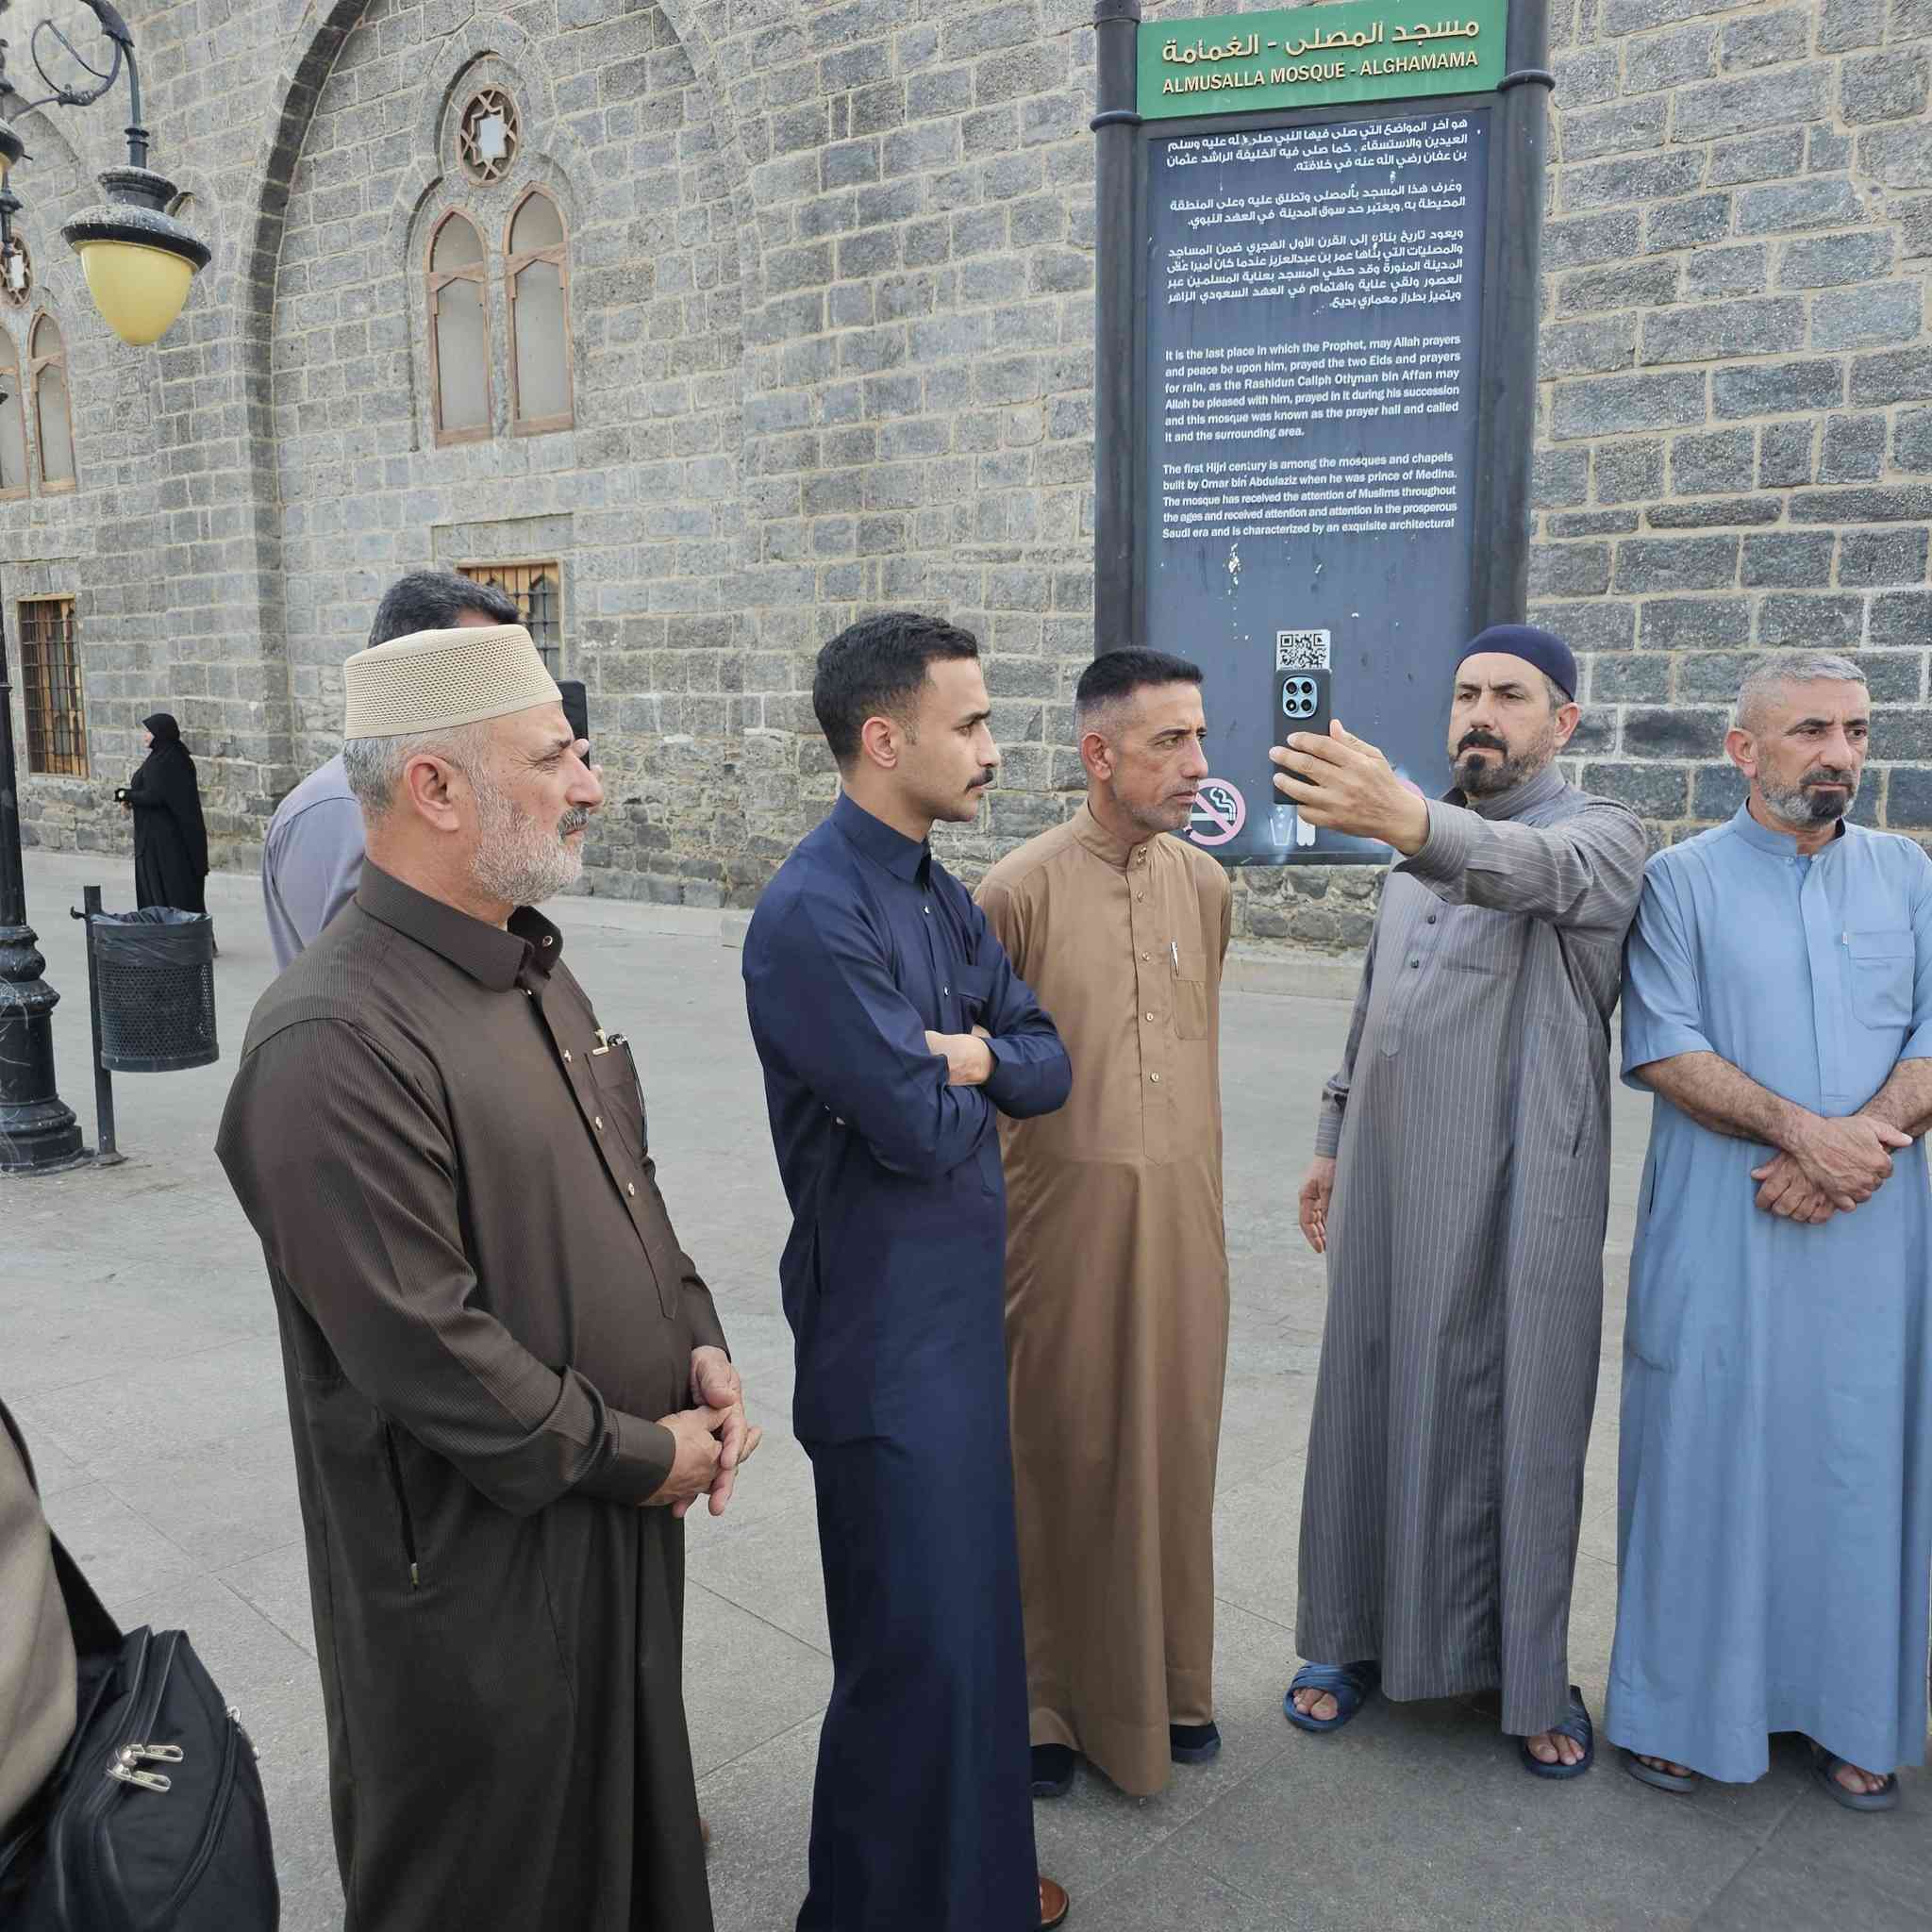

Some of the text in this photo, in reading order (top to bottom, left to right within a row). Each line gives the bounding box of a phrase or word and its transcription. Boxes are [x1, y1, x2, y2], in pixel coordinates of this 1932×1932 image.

[1285, 21, 1383, 56] المصلى
[1391, 19, 1480, 47] مسجد
[1162, 34, 1259, 64] الغمامة
[1162, 69, 1265, 94] ALMUSALLA
[1271, 61, 1346, 85] MOSQUE
[1359, 51, 1478, 76] ALGHAMAMA
[1354, 156, 1374, 166] عنه
[1376, 153, 1393, 165] الله
[1395, 152, 1422, 169] رضي
[1423, 149, 1451, 164] عفان
[1453, 149, 1467, 161] بن
[1334, 158, 1352, 173] في
[1362, 185, 1404, 200] المسجد
[1407, 183, 1427, 195] هذا
[1170, 198, 1213, 211] المنطقة
[1216, 196, 1244, 209] وعلى
[1247, 194, 1272, 208] عليه
[1274, 192, 1310, 205] وتطلق
[1357, 263, 1380, 275] وقد
[1383, 260, 1420, 275] المنورة
[1423, 257, 1462, 273] المدينة
[1187, 273, 1240, 288] المسلمين
[1241, 269, 1274, 284] بعناية
[1277, 267, 1319, 281] المسجد
[1424, 274, 1462, 287] العصور
[1167, 278, 1184, 289] عبر
[1252, 285, 1284, 295] العهد
[1287, 283, 1306, 298] في
[1308, 279, 1354, 294] واهتمام
[1357, 277, 1386, 291] عناية
[1390, 275, 1419, 291] ولقي
[1199, 287, 1248, 305] السعودي
[1174, 348, 1184, 359] is
[1186, 347, 1203, 358] the
[1205, 346, 1224, 358] last
[1226, 344, 1255, 359] place
[1257, 343, 1267, 356] in
[1269, 342, 1300, 355] which
[1302, 341, 1320, 353] the
[1322, 339, 1366, 355] Prophet,
[1369, 340, 1392, 352] may
[1392, 336, 1420, 348] Allah
[1422, 337, 1461, 349] prayers
[1165, 354, 1461, 378] and peace be upon him, prayed the two Eids and prayers
[1165, 381, 1179, 393] for
[1182, 380, 1206, 393] rain,
[1208, 382, 1221, 391] as
[1224, 378, 1241, 391] the
[1244, 376, 1294, 390] Rashidun
[1297, 375, 1331, 390] Caliph
[1401, 370, 1432, 382] Affan
[1435, 371, 1459, 383] may
[1164, 397, 1190, 409] Allah
[1191, 397, 1205, 408] be
[1207, 395, 1245, 410] pleased
[1246, 394, 1268, 406] with
[1270, 392, 1292, 406] him,
[1294, 391, 1328, 406] prayed
[1330, 391, 1341, 402] in
[1351, 389, 1385, 404] during
[1386, 388, 1402, 399] his
[1403, 385, 1459, 398] succession
[1164, 402, 1458, 426] and this mosque was known as the prayer hall and called
[1174, 430, 1193, 442] and
[1195, 429, 1212, 441] the
[1214, 426, 1275, 443] surrounding
[1277, 428, 1304, 438] area.
[1162, 463, 1181, 475] The
[1181, 462, 1204, 474] first
[1268, 458, 1278, 470] is
[1280, 459, 1317, 473] among
[1319, 457, 1336, 468] the
[1339, 457, 1387, 470] mosques
[1389, 454, 1409, 465] and
[1411, 452, 1453, 467] chapels
[1163, 479, 1185, 491] built
[1187, 478, 1200, 492] by
[1200, 477, 1229, 489] Omar
[1248, 474, 1297, 487] Abdulaziz
[1299, 473, 1326, 485] when
[1329, 472, 1342, 483] he
[1344, 474, 1366, 483] was
[1367, 470, 1400, 484] prince
[1402, 469, 1413, 480] of
[1415, 467, 1457, 479] Medina.
[1162, 485, 1457, 509] The mosque has received the attention of Muslims throughout
[1163, 511, 1178, 524] the
[1204, 509, 1223, 522] and
[1224, 508, 1263, 521] received
[1264, 507, 1307, 519] attention
[1307, 506, 1327, 517] and
[1328, 504, 1372, 517] attention
[1374, 504, 1383, 515] in
[1385, 503, 1401, 514] the
[1402, 503, 1457, 516] prosperous
[1161, 518, 1454, 539] Saudi era and is characterized by an exquisite architectural
